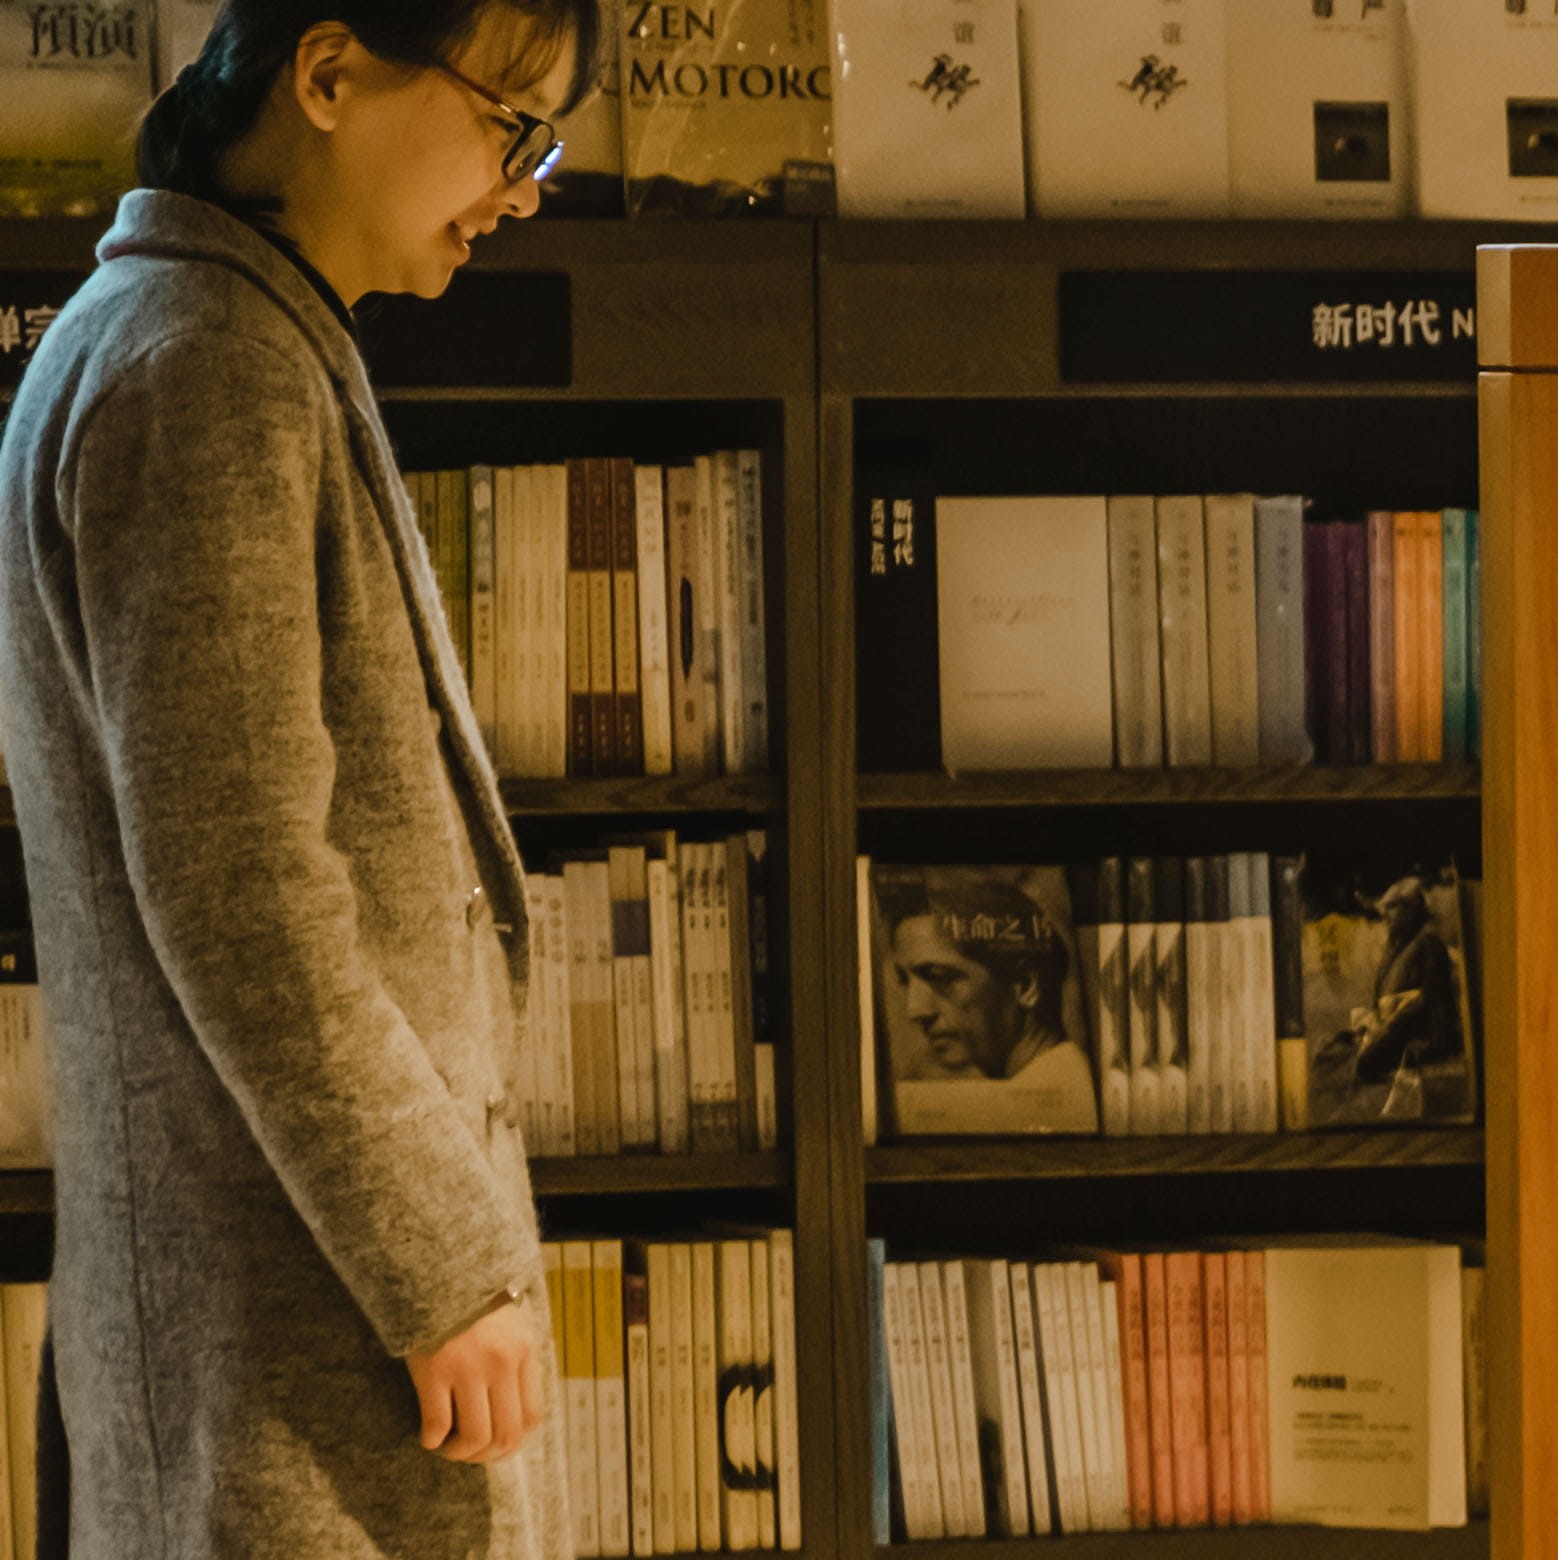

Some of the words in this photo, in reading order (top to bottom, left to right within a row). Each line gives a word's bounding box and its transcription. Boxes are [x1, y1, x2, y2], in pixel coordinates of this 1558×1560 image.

[627, 0, 716, 40] ZEN
[1312, 301, 1441, 348] 新时代
